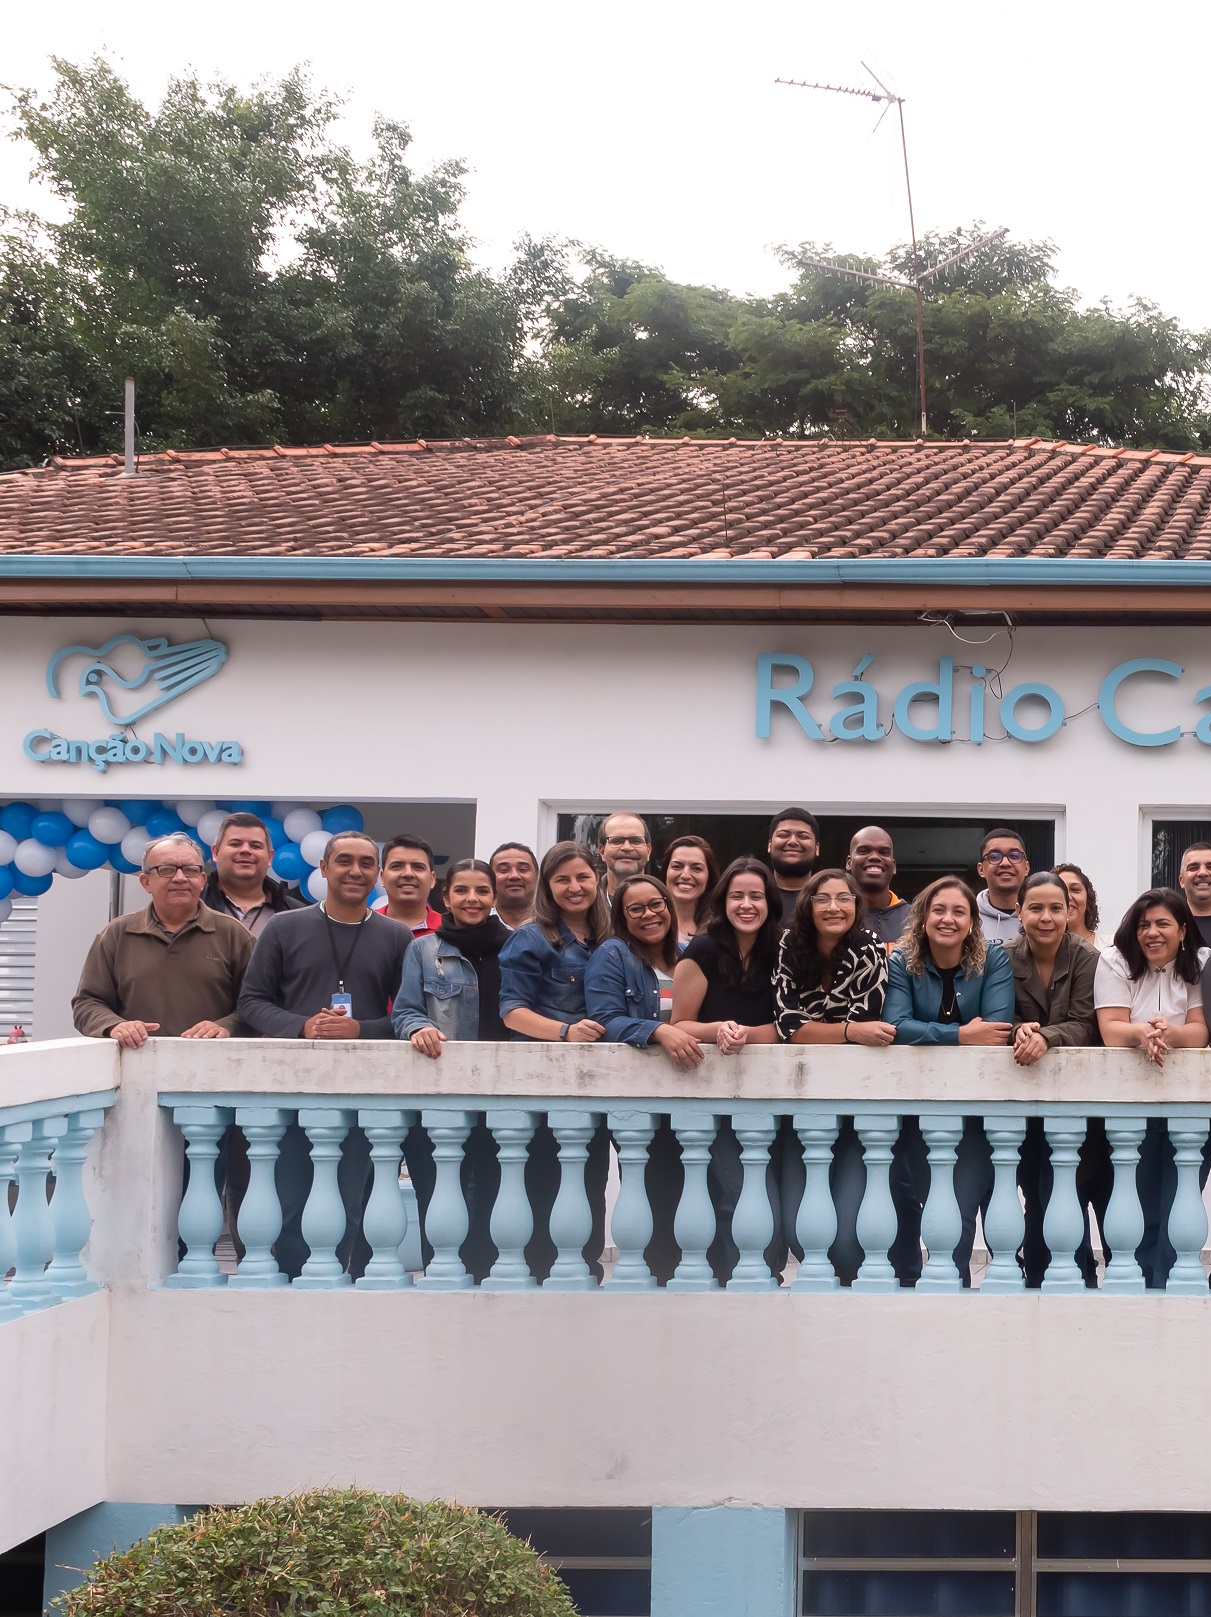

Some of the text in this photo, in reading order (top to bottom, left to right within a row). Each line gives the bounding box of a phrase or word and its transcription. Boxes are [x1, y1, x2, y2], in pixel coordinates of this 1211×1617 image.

[755, 653, 1066, 743] Rádio
[22, 728, 244, 773] Canção Nova
